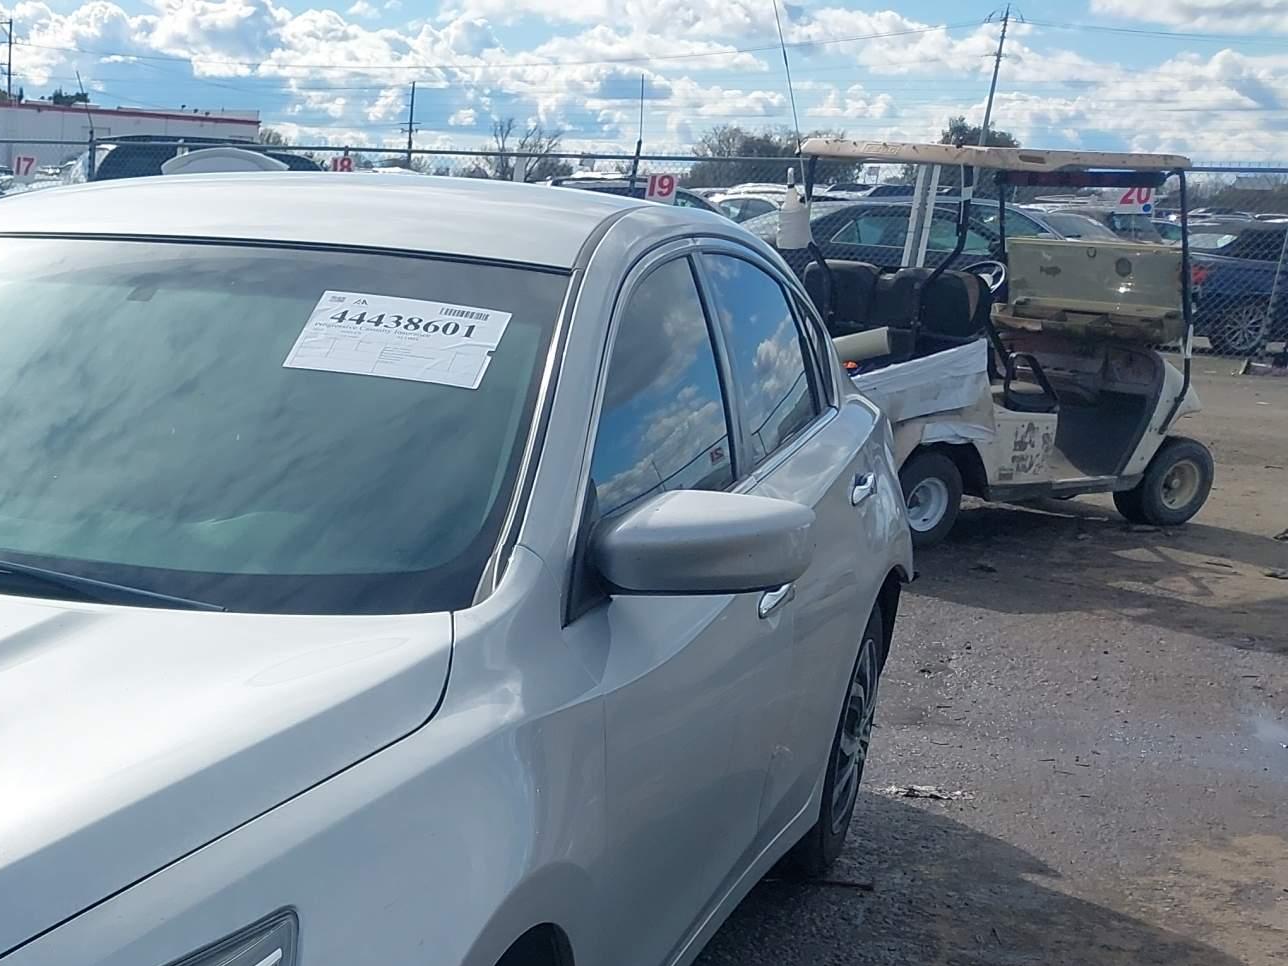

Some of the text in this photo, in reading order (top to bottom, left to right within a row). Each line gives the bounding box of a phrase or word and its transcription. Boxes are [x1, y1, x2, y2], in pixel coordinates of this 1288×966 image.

[15, 157, 35, 176] 17
[332, 157, 354, 172] 18
[648, 175, 675, 197] 19
[1119, 187, 1152, 205] 20
[330, 309, 476, 338] 44438601
